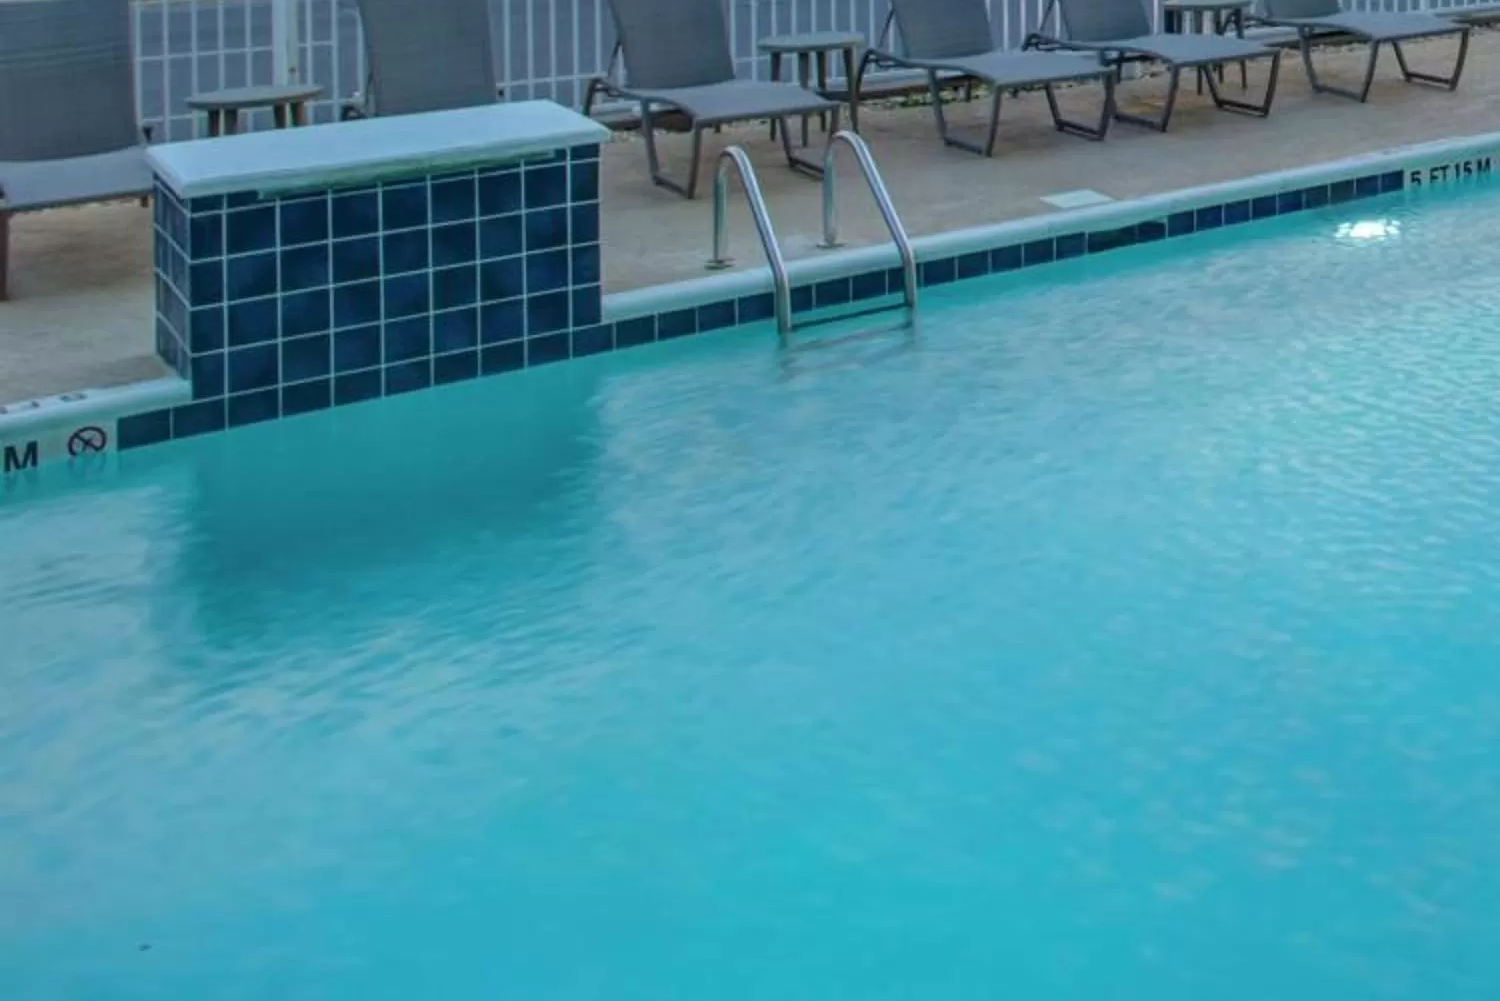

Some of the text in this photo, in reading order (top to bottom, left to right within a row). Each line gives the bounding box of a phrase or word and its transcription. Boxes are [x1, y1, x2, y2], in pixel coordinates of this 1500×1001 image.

[1429, 164, 1450, 184] FT
[1476, 157, 1491, 176] M
[3, 440, 39, 473] M
